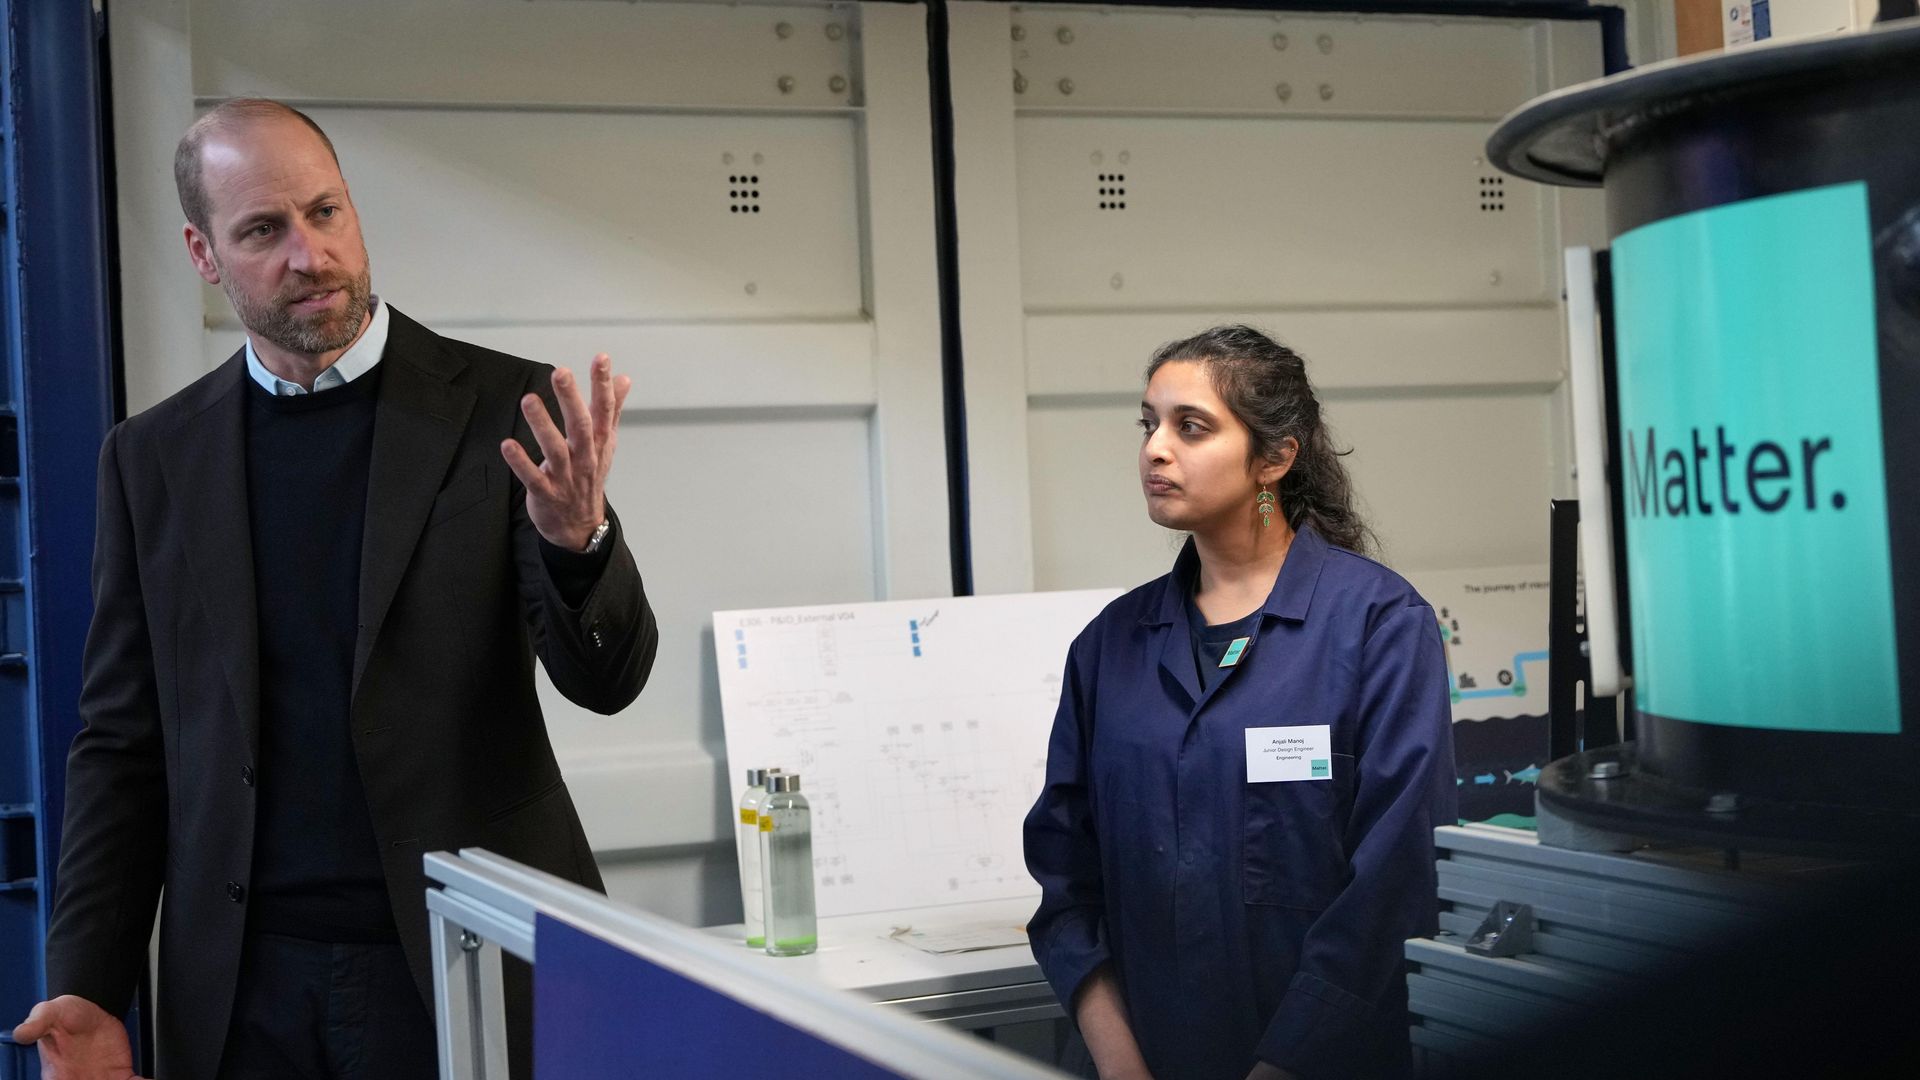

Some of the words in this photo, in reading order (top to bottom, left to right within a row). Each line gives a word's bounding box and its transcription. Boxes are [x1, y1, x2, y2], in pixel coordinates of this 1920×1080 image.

[1627, 424, 1847, 518] Matter.
[1464, 584, 1481, 593] The
[1483, 583, 1515, 594] journey
[1518, 581, 1528, 590] of
